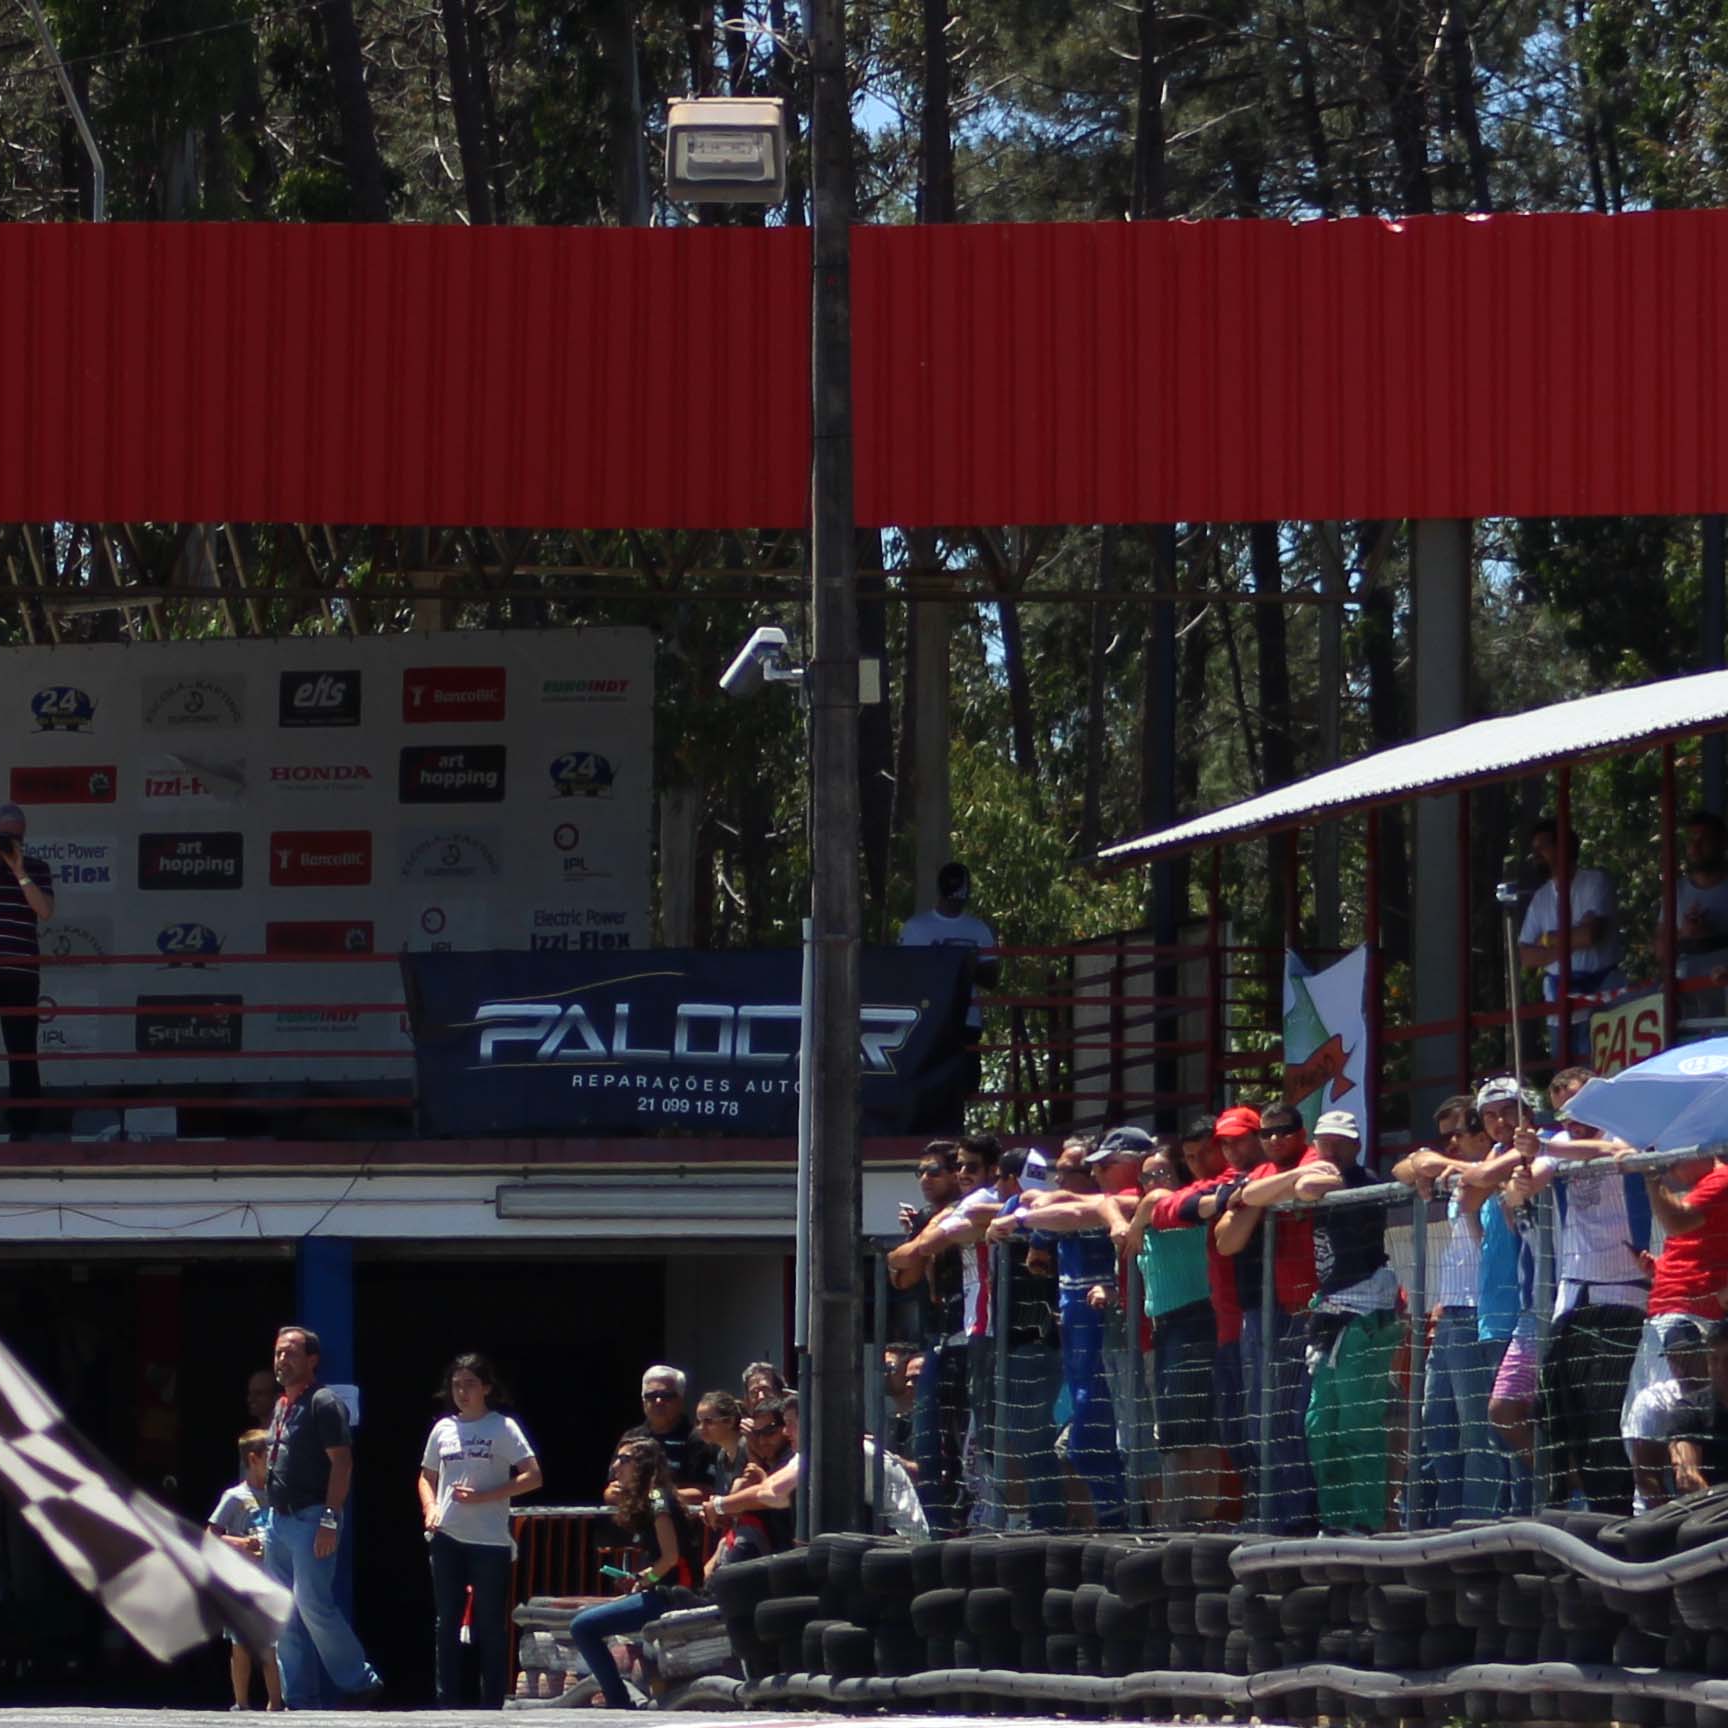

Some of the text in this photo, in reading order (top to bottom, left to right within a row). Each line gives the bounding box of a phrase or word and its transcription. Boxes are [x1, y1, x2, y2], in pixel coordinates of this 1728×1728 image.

[40, 690, 80, 713] 24
[270, 766, 372, 781] HONDA
[559, 755, 597, 780] 24
[168, 926, 204, 951] 24
[1590, 1009, 1662, 1075] GAS
[572, 1072, 731, 1094] REPARAÇÕES
[637, 1097, 739, 1117] 21 099 18 78
